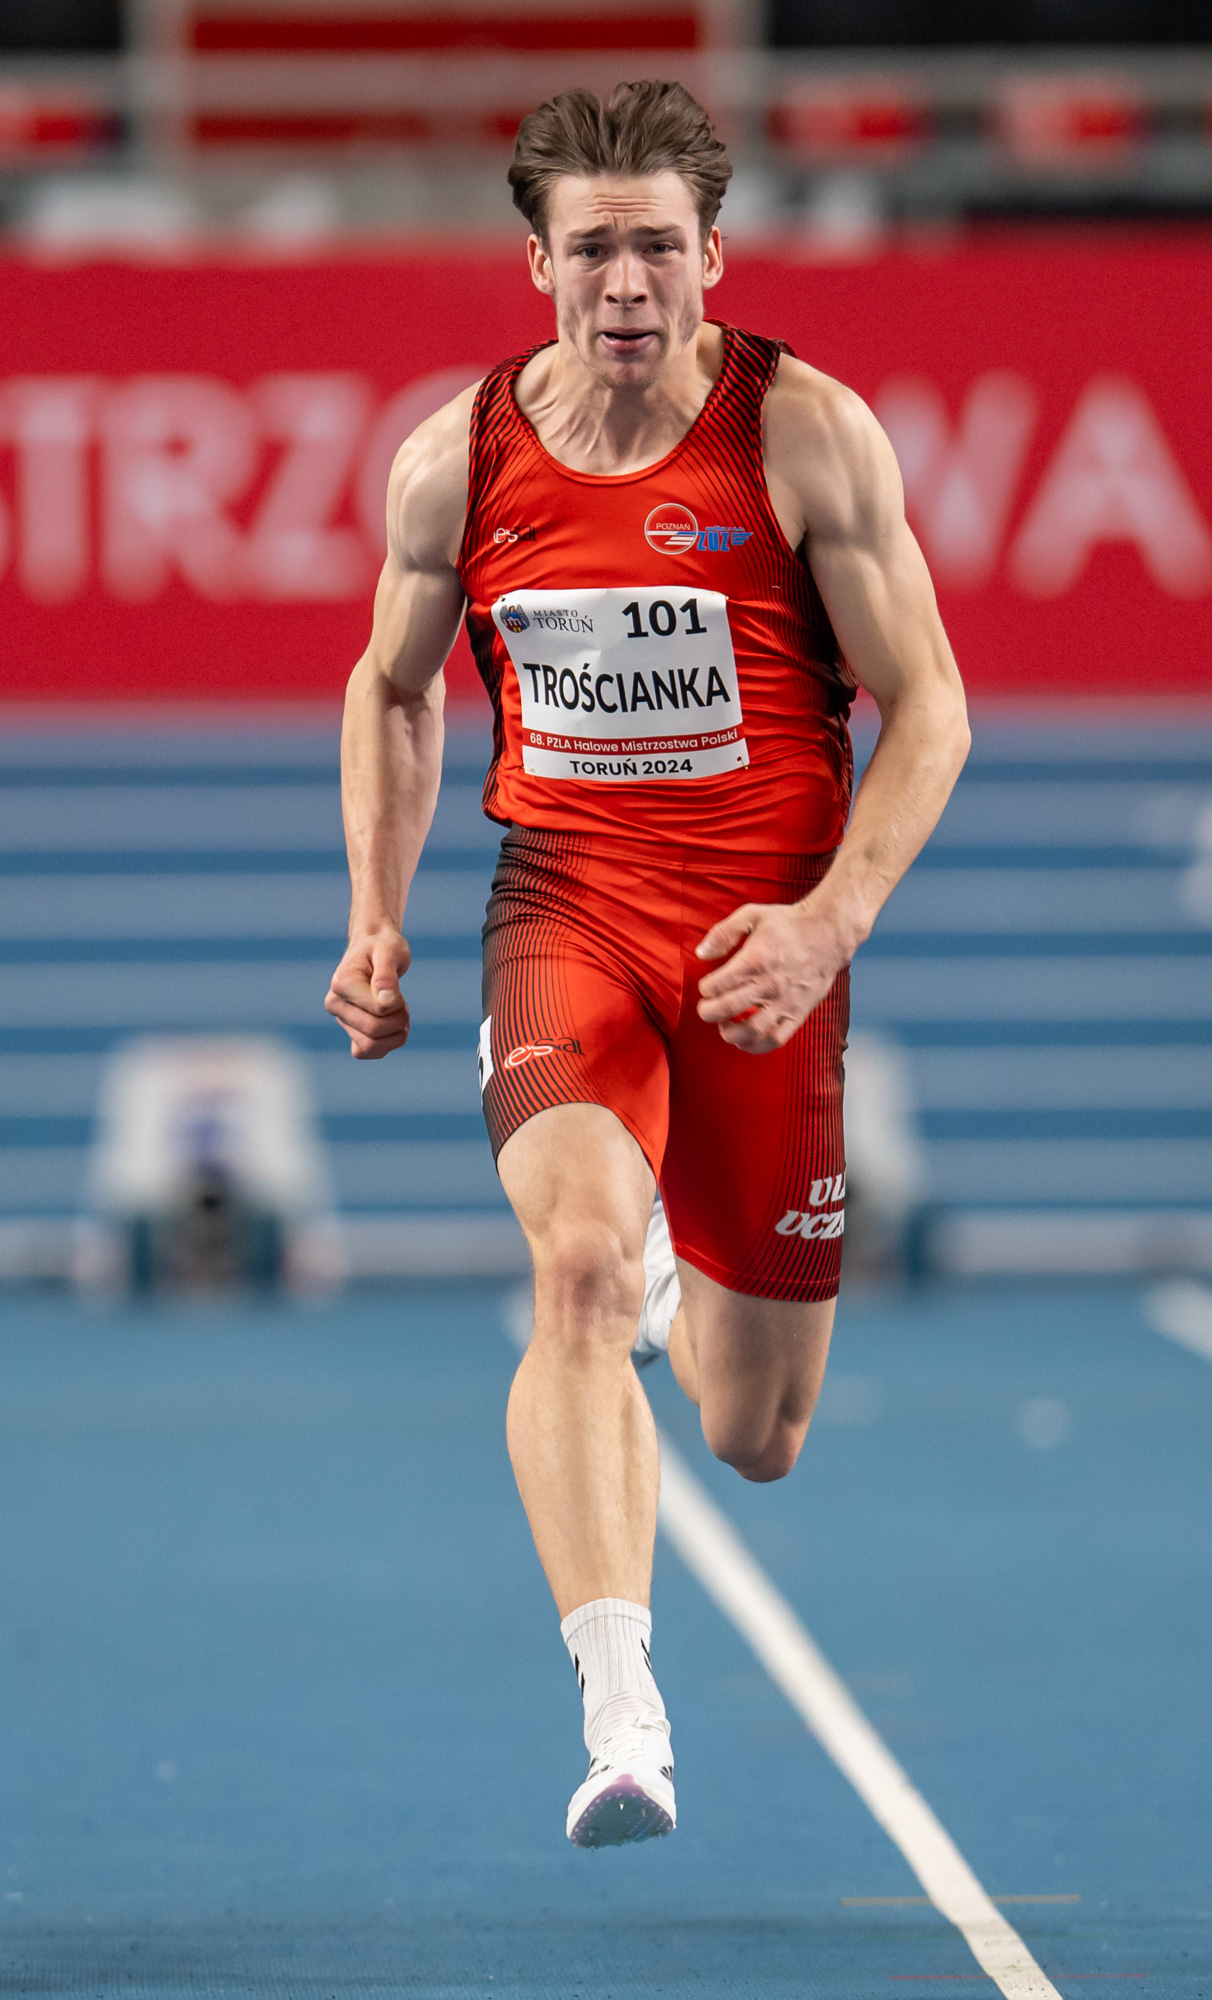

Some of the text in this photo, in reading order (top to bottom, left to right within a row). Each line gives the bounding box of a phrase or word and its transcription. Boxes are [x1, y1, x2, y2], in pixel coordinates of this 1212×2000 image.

[655, 522, 691, 531] POZNAŃ
[696, 531, 730, 552] ZUZ
[533, 609, 578, 618] MIASTO
[533, 615, 594, 633] TORUŃ
[621, 598, 708, 638] 101
[522, 663, 731, 713] TROŚCIANKA
[529, 729, 738, 752] 68. PZLA Halowe Mistrzostwa Polski
[570, 758, 693, 776] TORUŃ 2024
[809, 1172, 846, 1207] UL
[774, 1207, 845, 1240] UCZ
